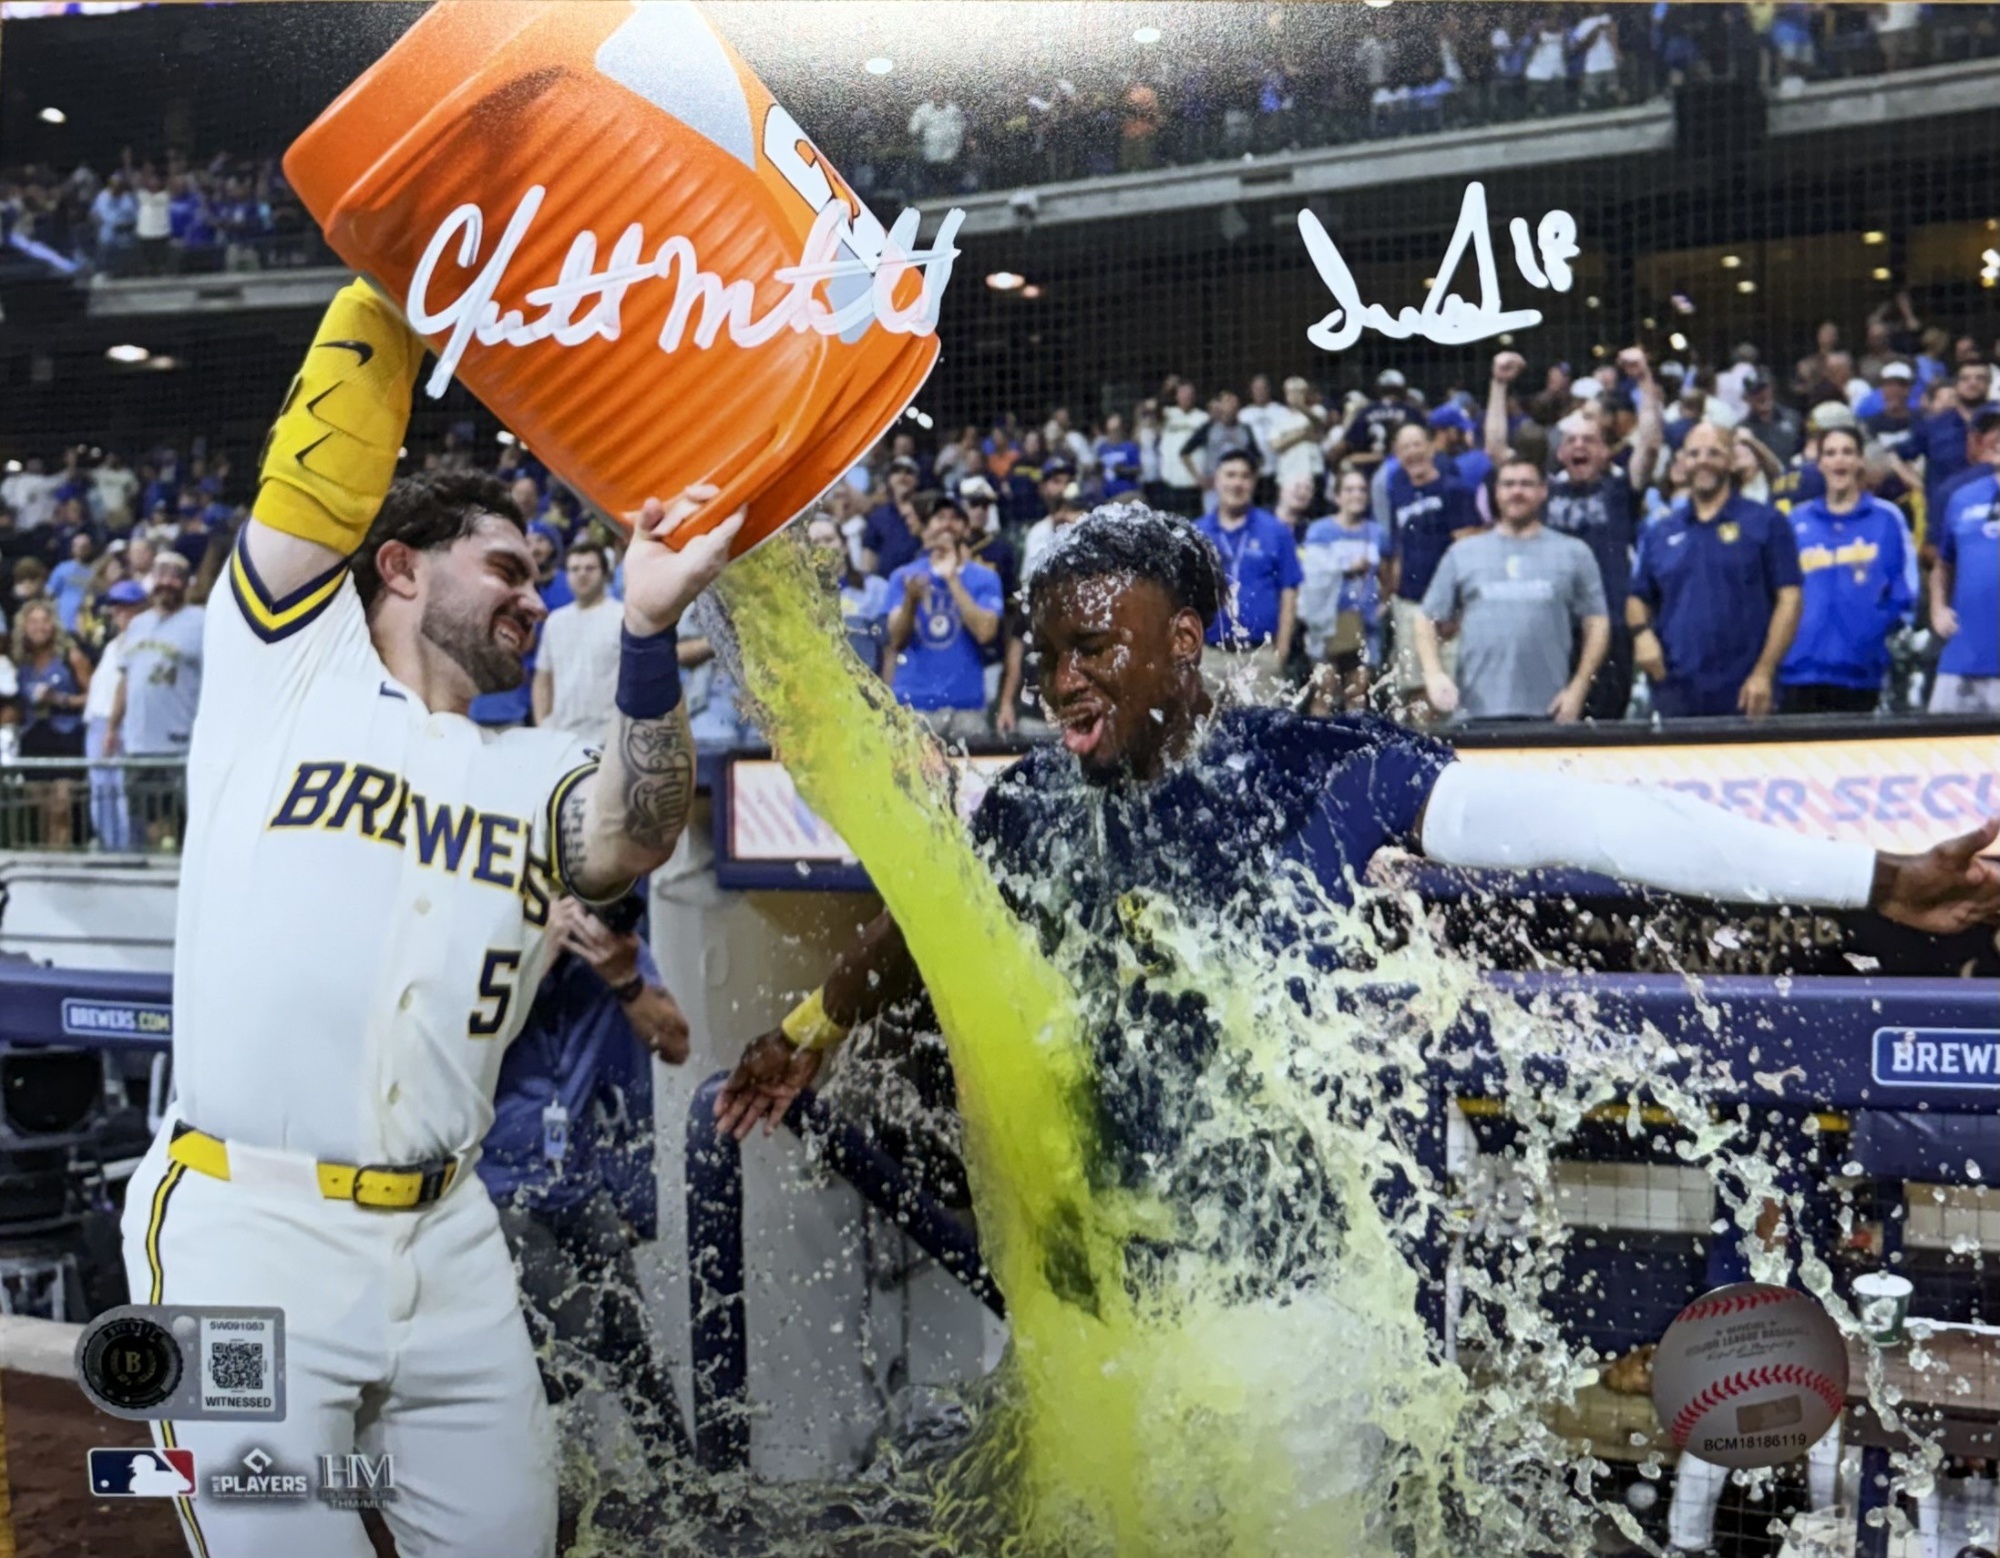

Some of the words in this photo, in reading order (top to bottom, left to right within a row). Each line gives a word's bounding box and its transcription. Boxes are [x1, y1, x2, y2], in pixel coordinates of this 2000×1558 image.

[468, 947, 524, 1039] 5
[125, 1351, 142, 1373] B
[205, 1396, 272, 1409] WITNESSED
[1703, 1432, 1807, 1452] BCM18186119
